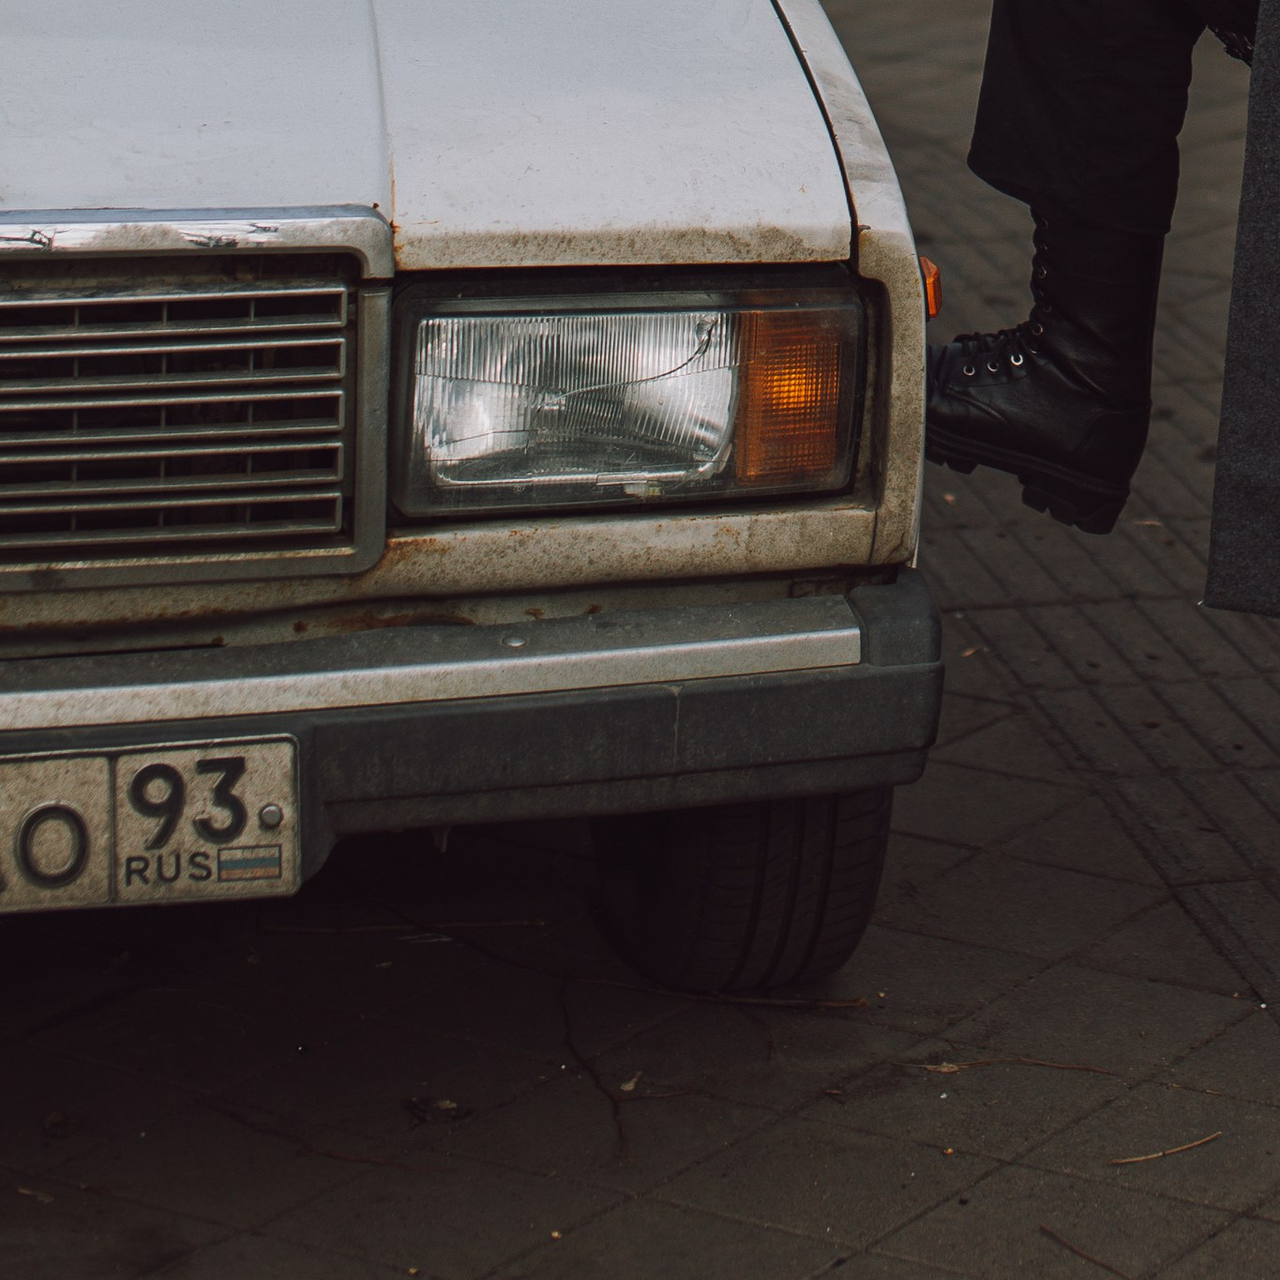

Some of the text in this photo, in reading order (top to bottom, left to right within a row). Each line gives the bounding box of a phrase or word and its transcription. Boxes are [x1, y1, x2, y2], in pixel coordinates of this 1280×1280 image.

[0, 756, 247, 889] O 93
[125, 850, 213, 886] RUS
